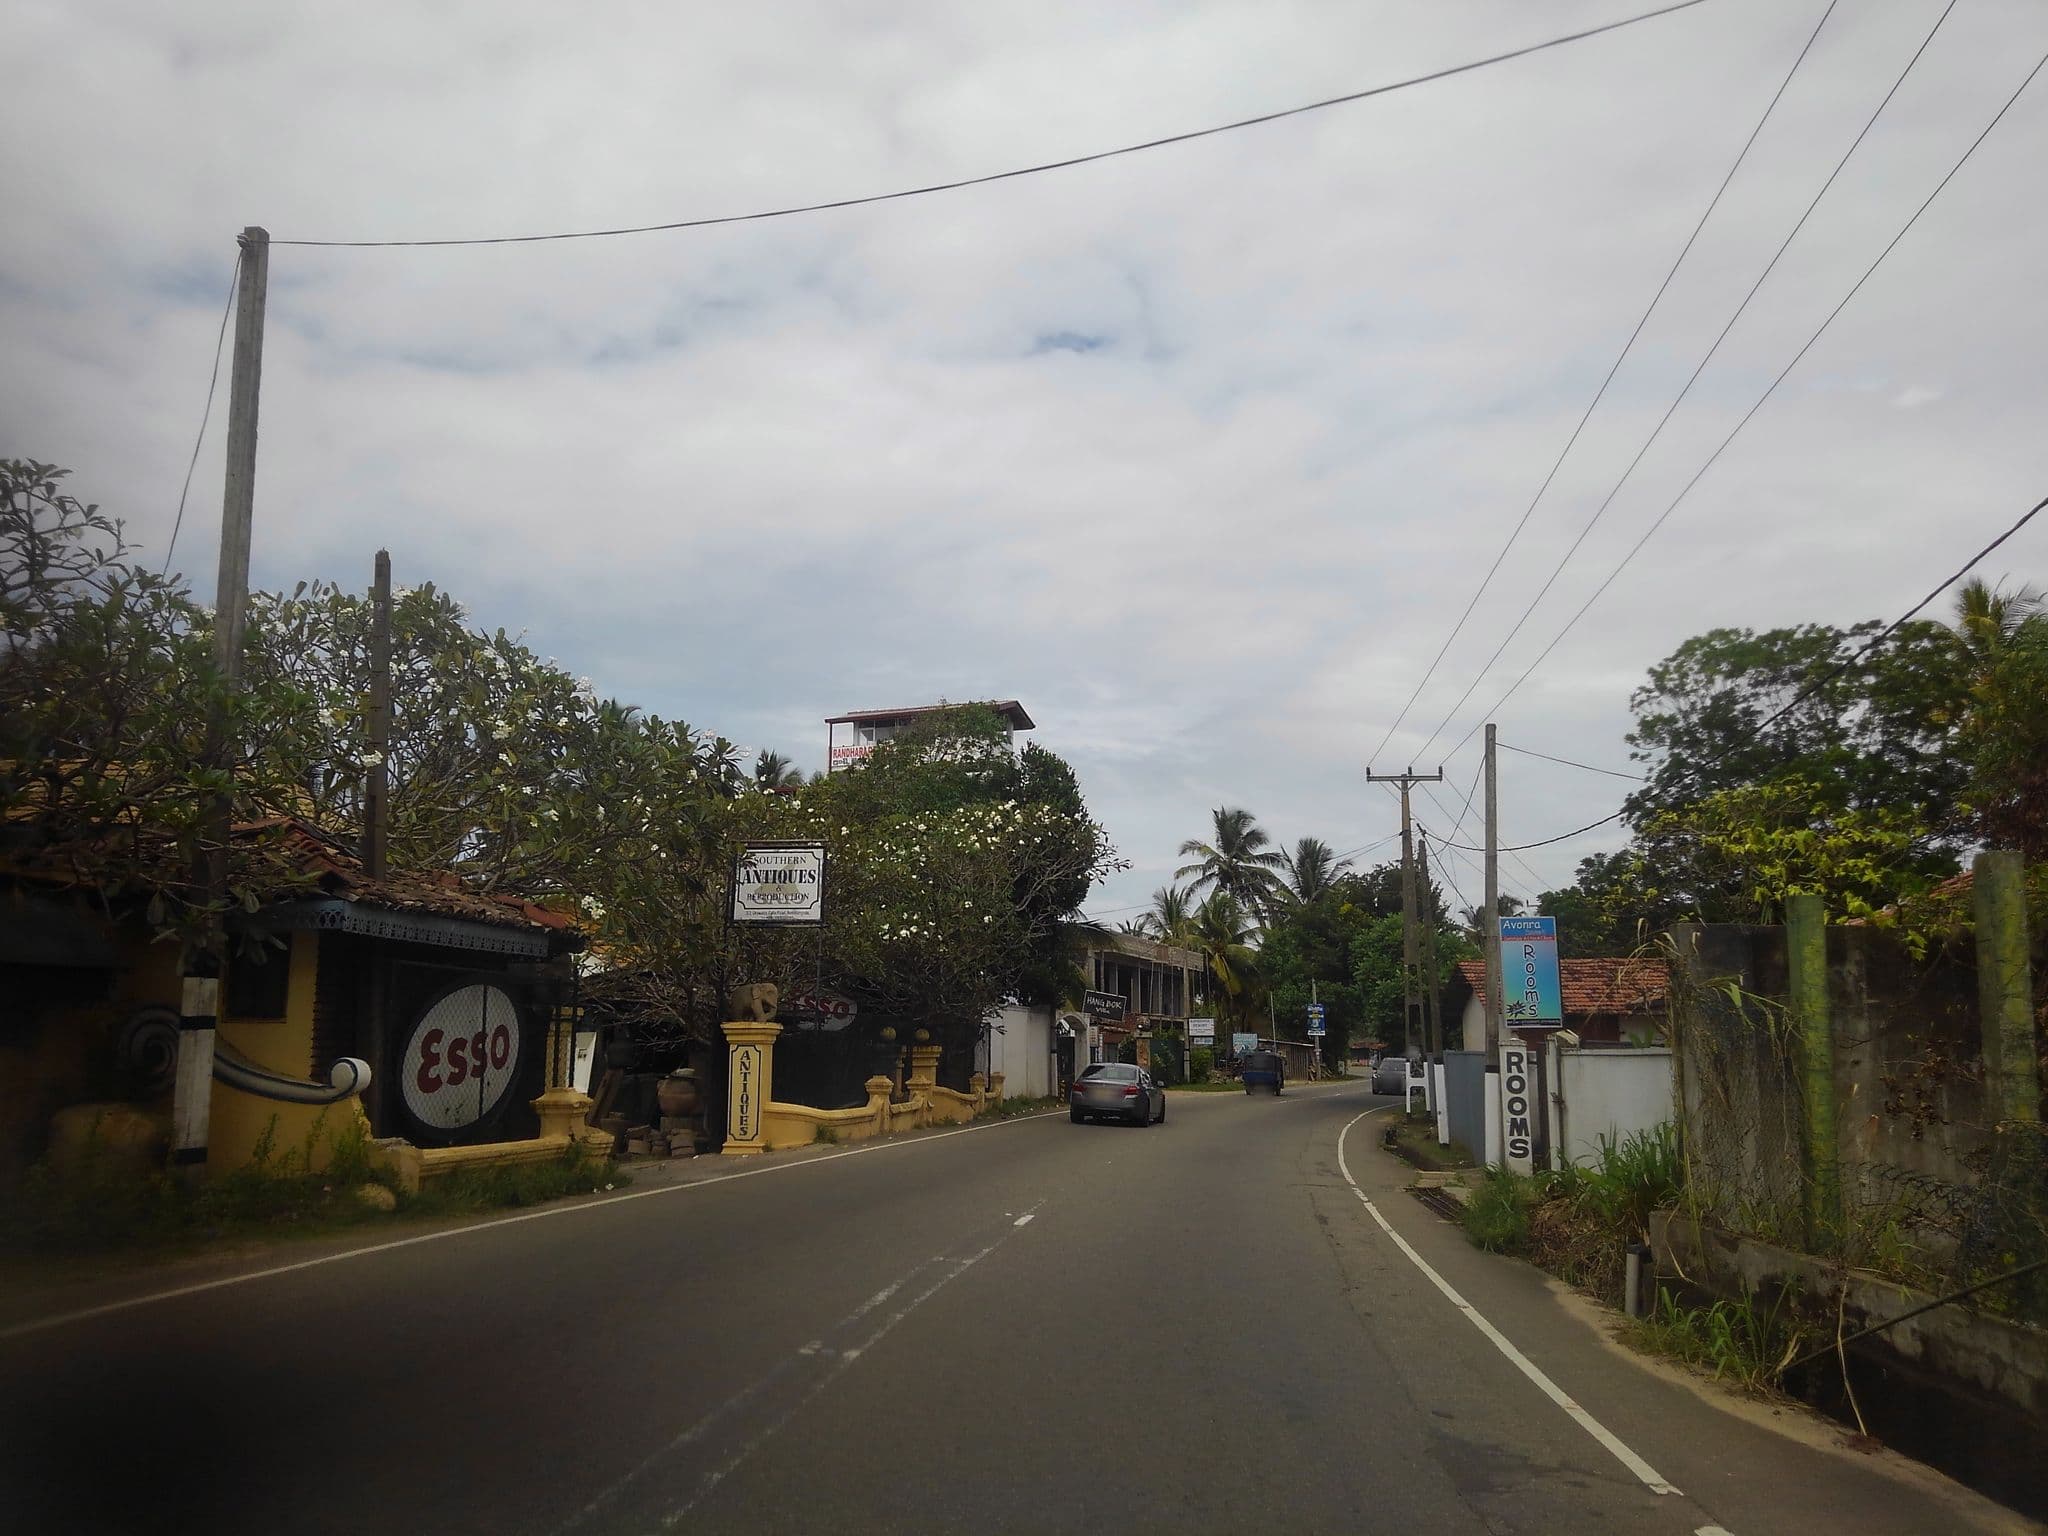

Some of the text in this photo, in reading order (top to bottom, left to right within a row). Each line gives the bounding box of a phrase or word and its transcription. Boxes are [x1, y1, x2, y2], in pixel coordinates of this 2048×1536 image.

[754, 856, 807, 865] SOUTHERN
[743, 869, 817, 884] ANTIQUES
[747, 893, 810, 901] REPRODUCTION
[1503, 920, 1541, 930] Avonra
[1523, 944, 1540, 1017] Rooms
[739, 1050, 751, 1136] ANTIQUES
[1506, 1051, 1530, 1159] ROOMS
